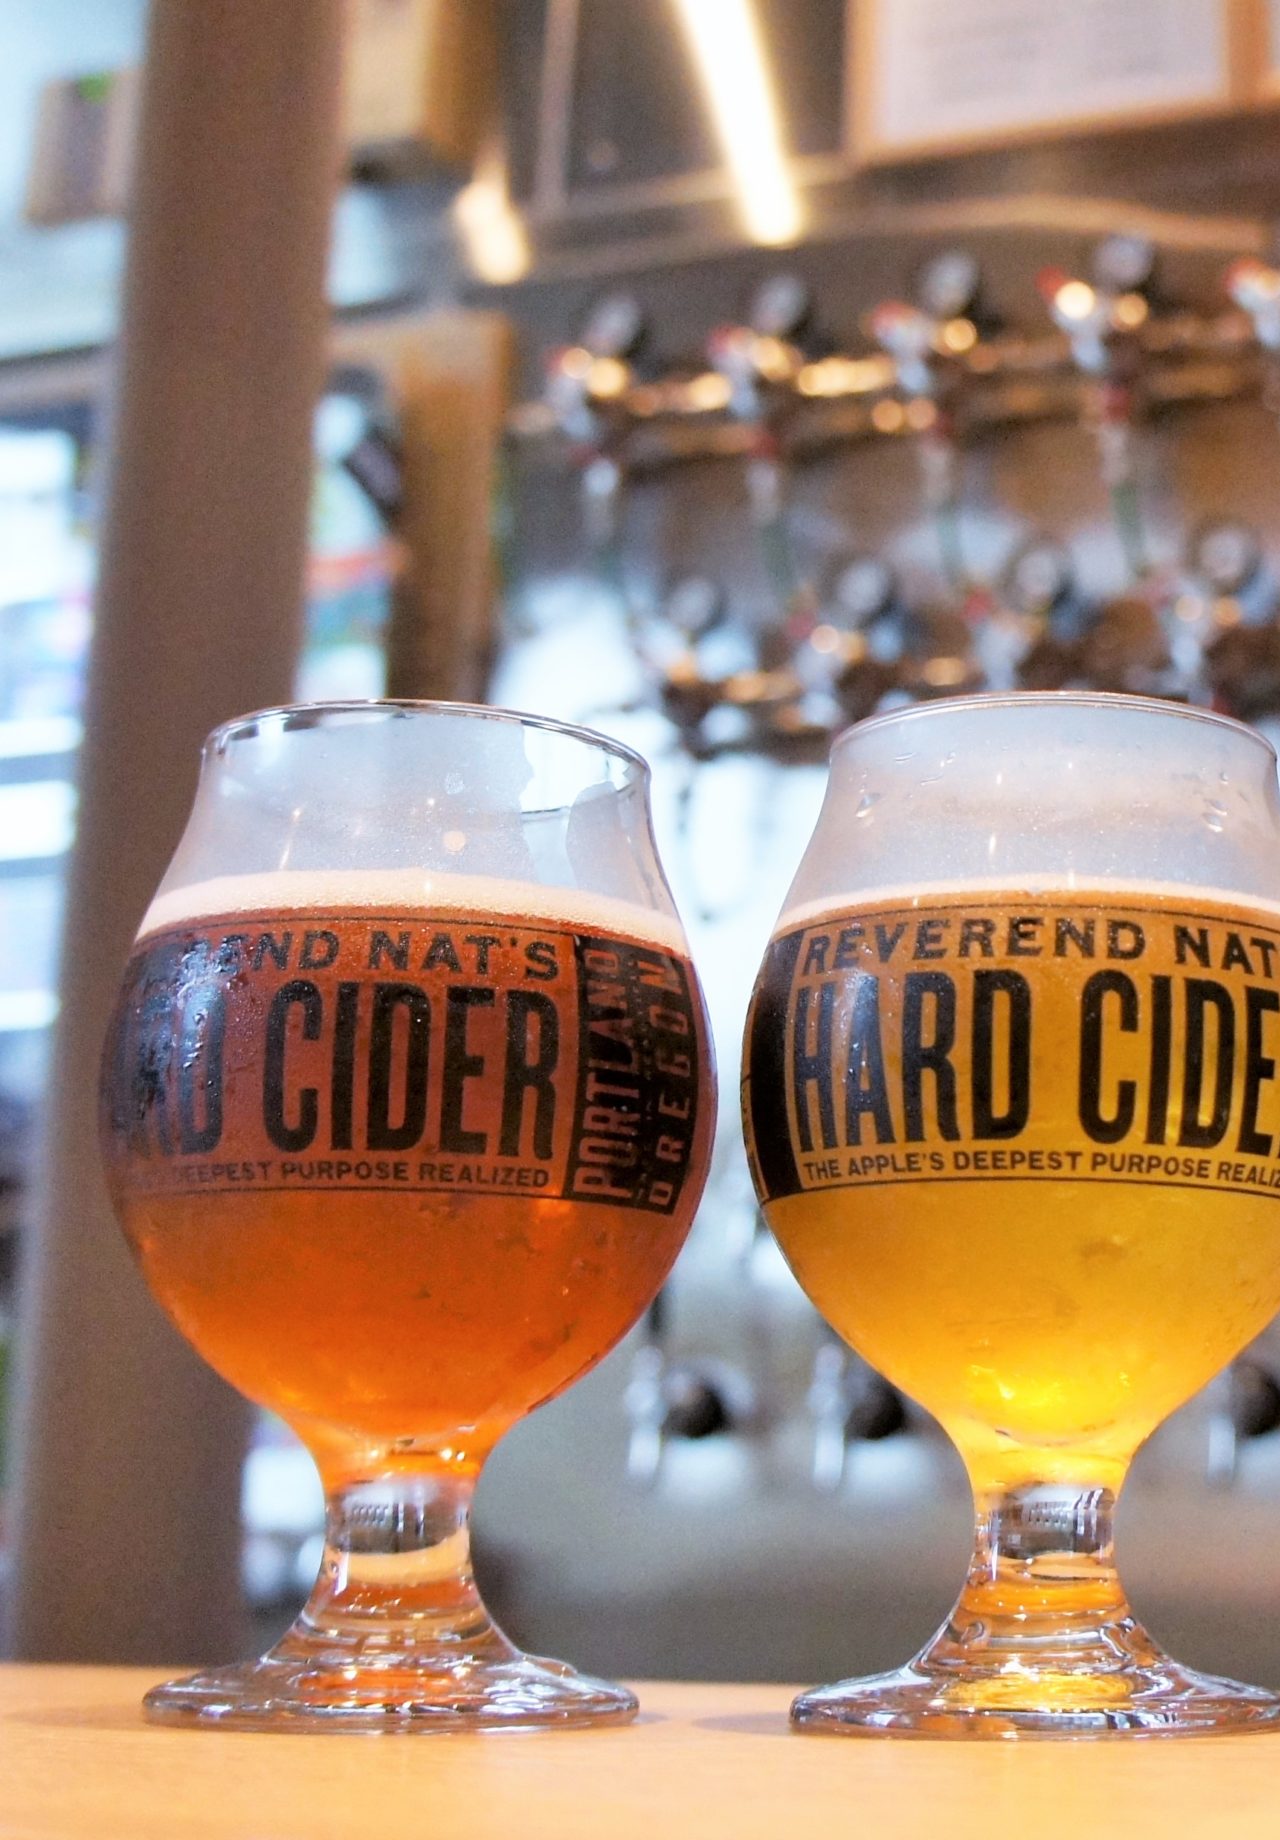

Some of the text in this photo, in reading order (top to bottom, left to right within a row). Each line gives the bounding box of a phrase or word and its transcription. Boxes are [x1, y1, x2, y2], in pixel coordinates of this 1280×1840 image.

[368, 928, 558, 981] NAT'S
[803, 916, 1147, 977] REVEREND
[263, 979, 560, 1162] CIDER
[573, 949, 641, 1198] PORTLAND
[638, 960, 691, 1206] OREGON
[795, 969, 1032, 1154] HARD
[281, 1159, 409, 1184] PURPOSE
[418, 1162, 551, 1191] REALIZED
[803, 1158, 844, 1182] THE
[847, 1152, 945, 1177] APPLE'S
[953, 1150, 1081, 1174] DEEPEST
[1091, 1153, 1211, 1180] PURPOSE
